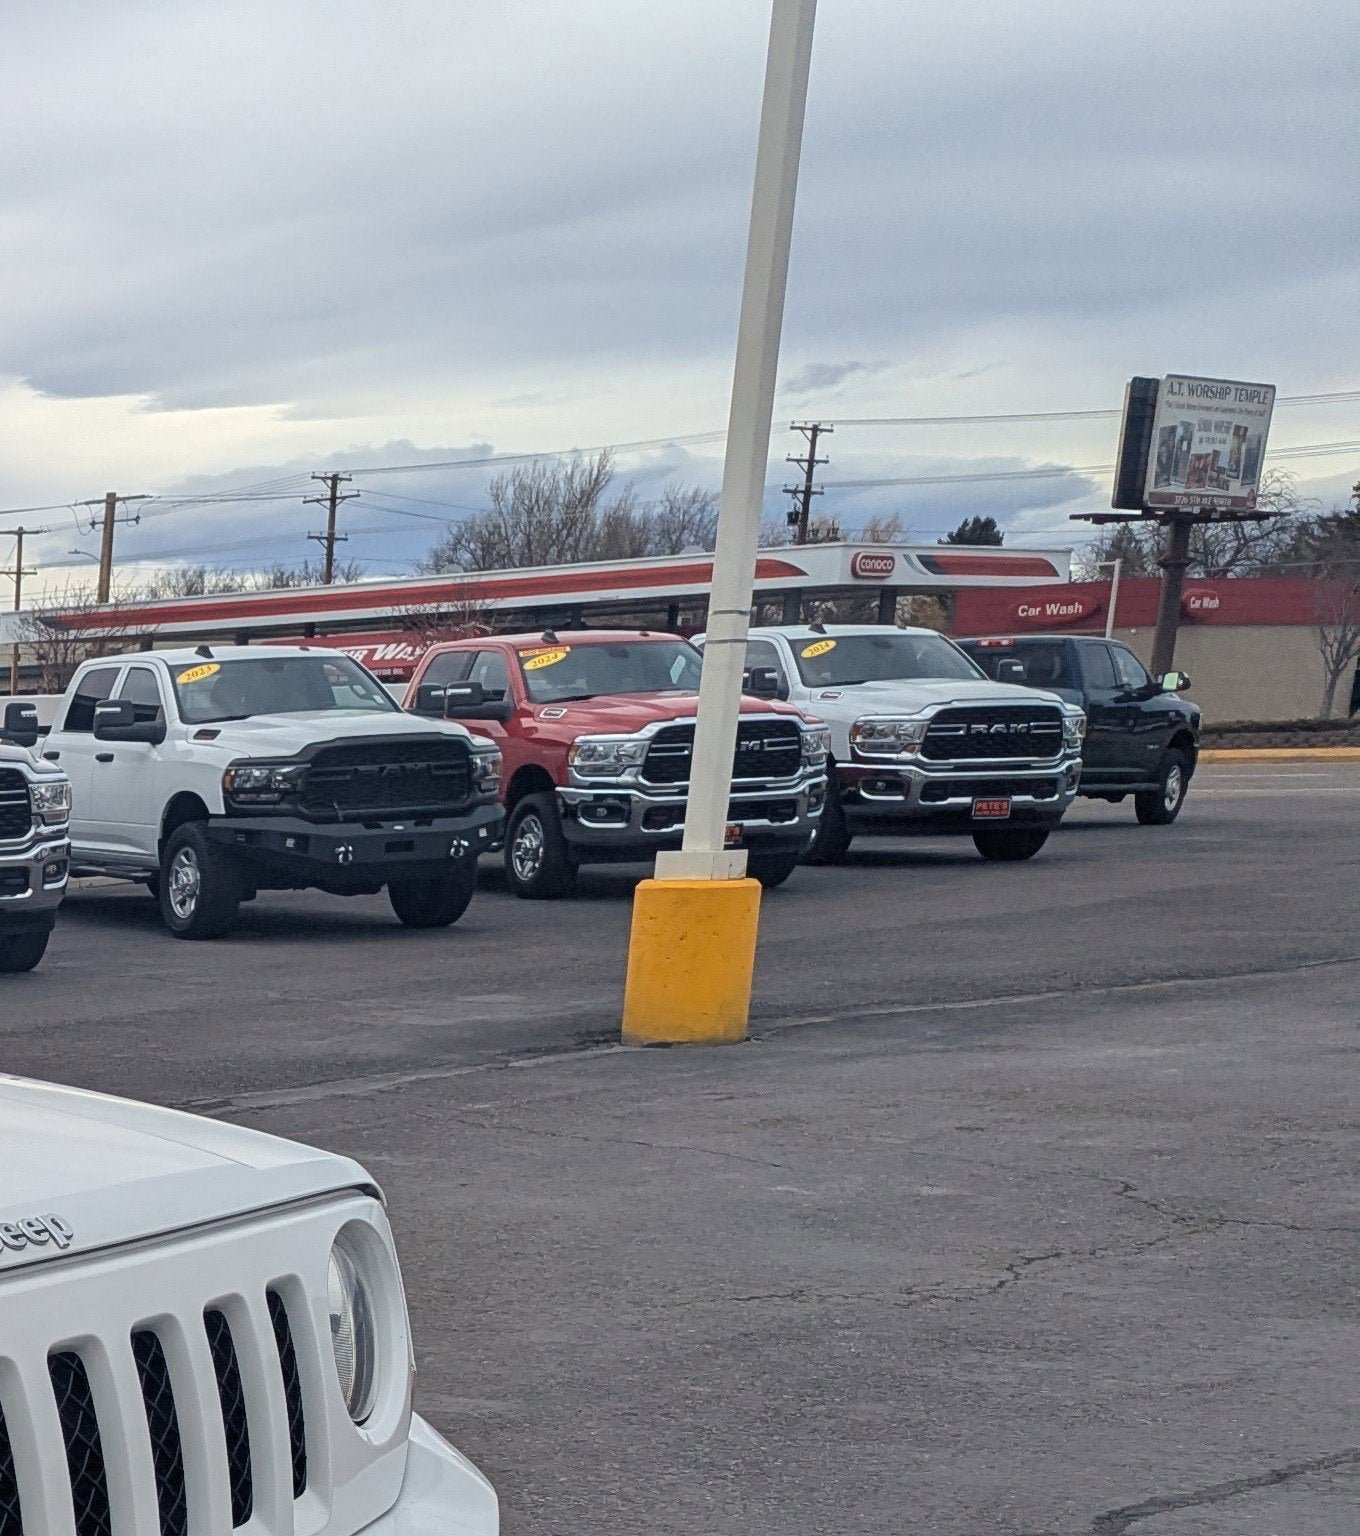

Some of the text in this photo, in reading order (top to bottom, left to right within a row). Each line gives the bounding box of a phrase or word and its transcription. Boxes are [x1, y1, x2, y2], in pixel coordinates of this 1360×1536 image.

[1188, 383, 1231, 400] WORSHIP
[1234, 387, 1269, 405] TEMPLE
[861, 559, 893, 570] conoco
[1190, 596, 1220, 608] Car Wash
[1018, 602, 1083, 617] Car Wash
[971, 723, 1029, 733] RAM
